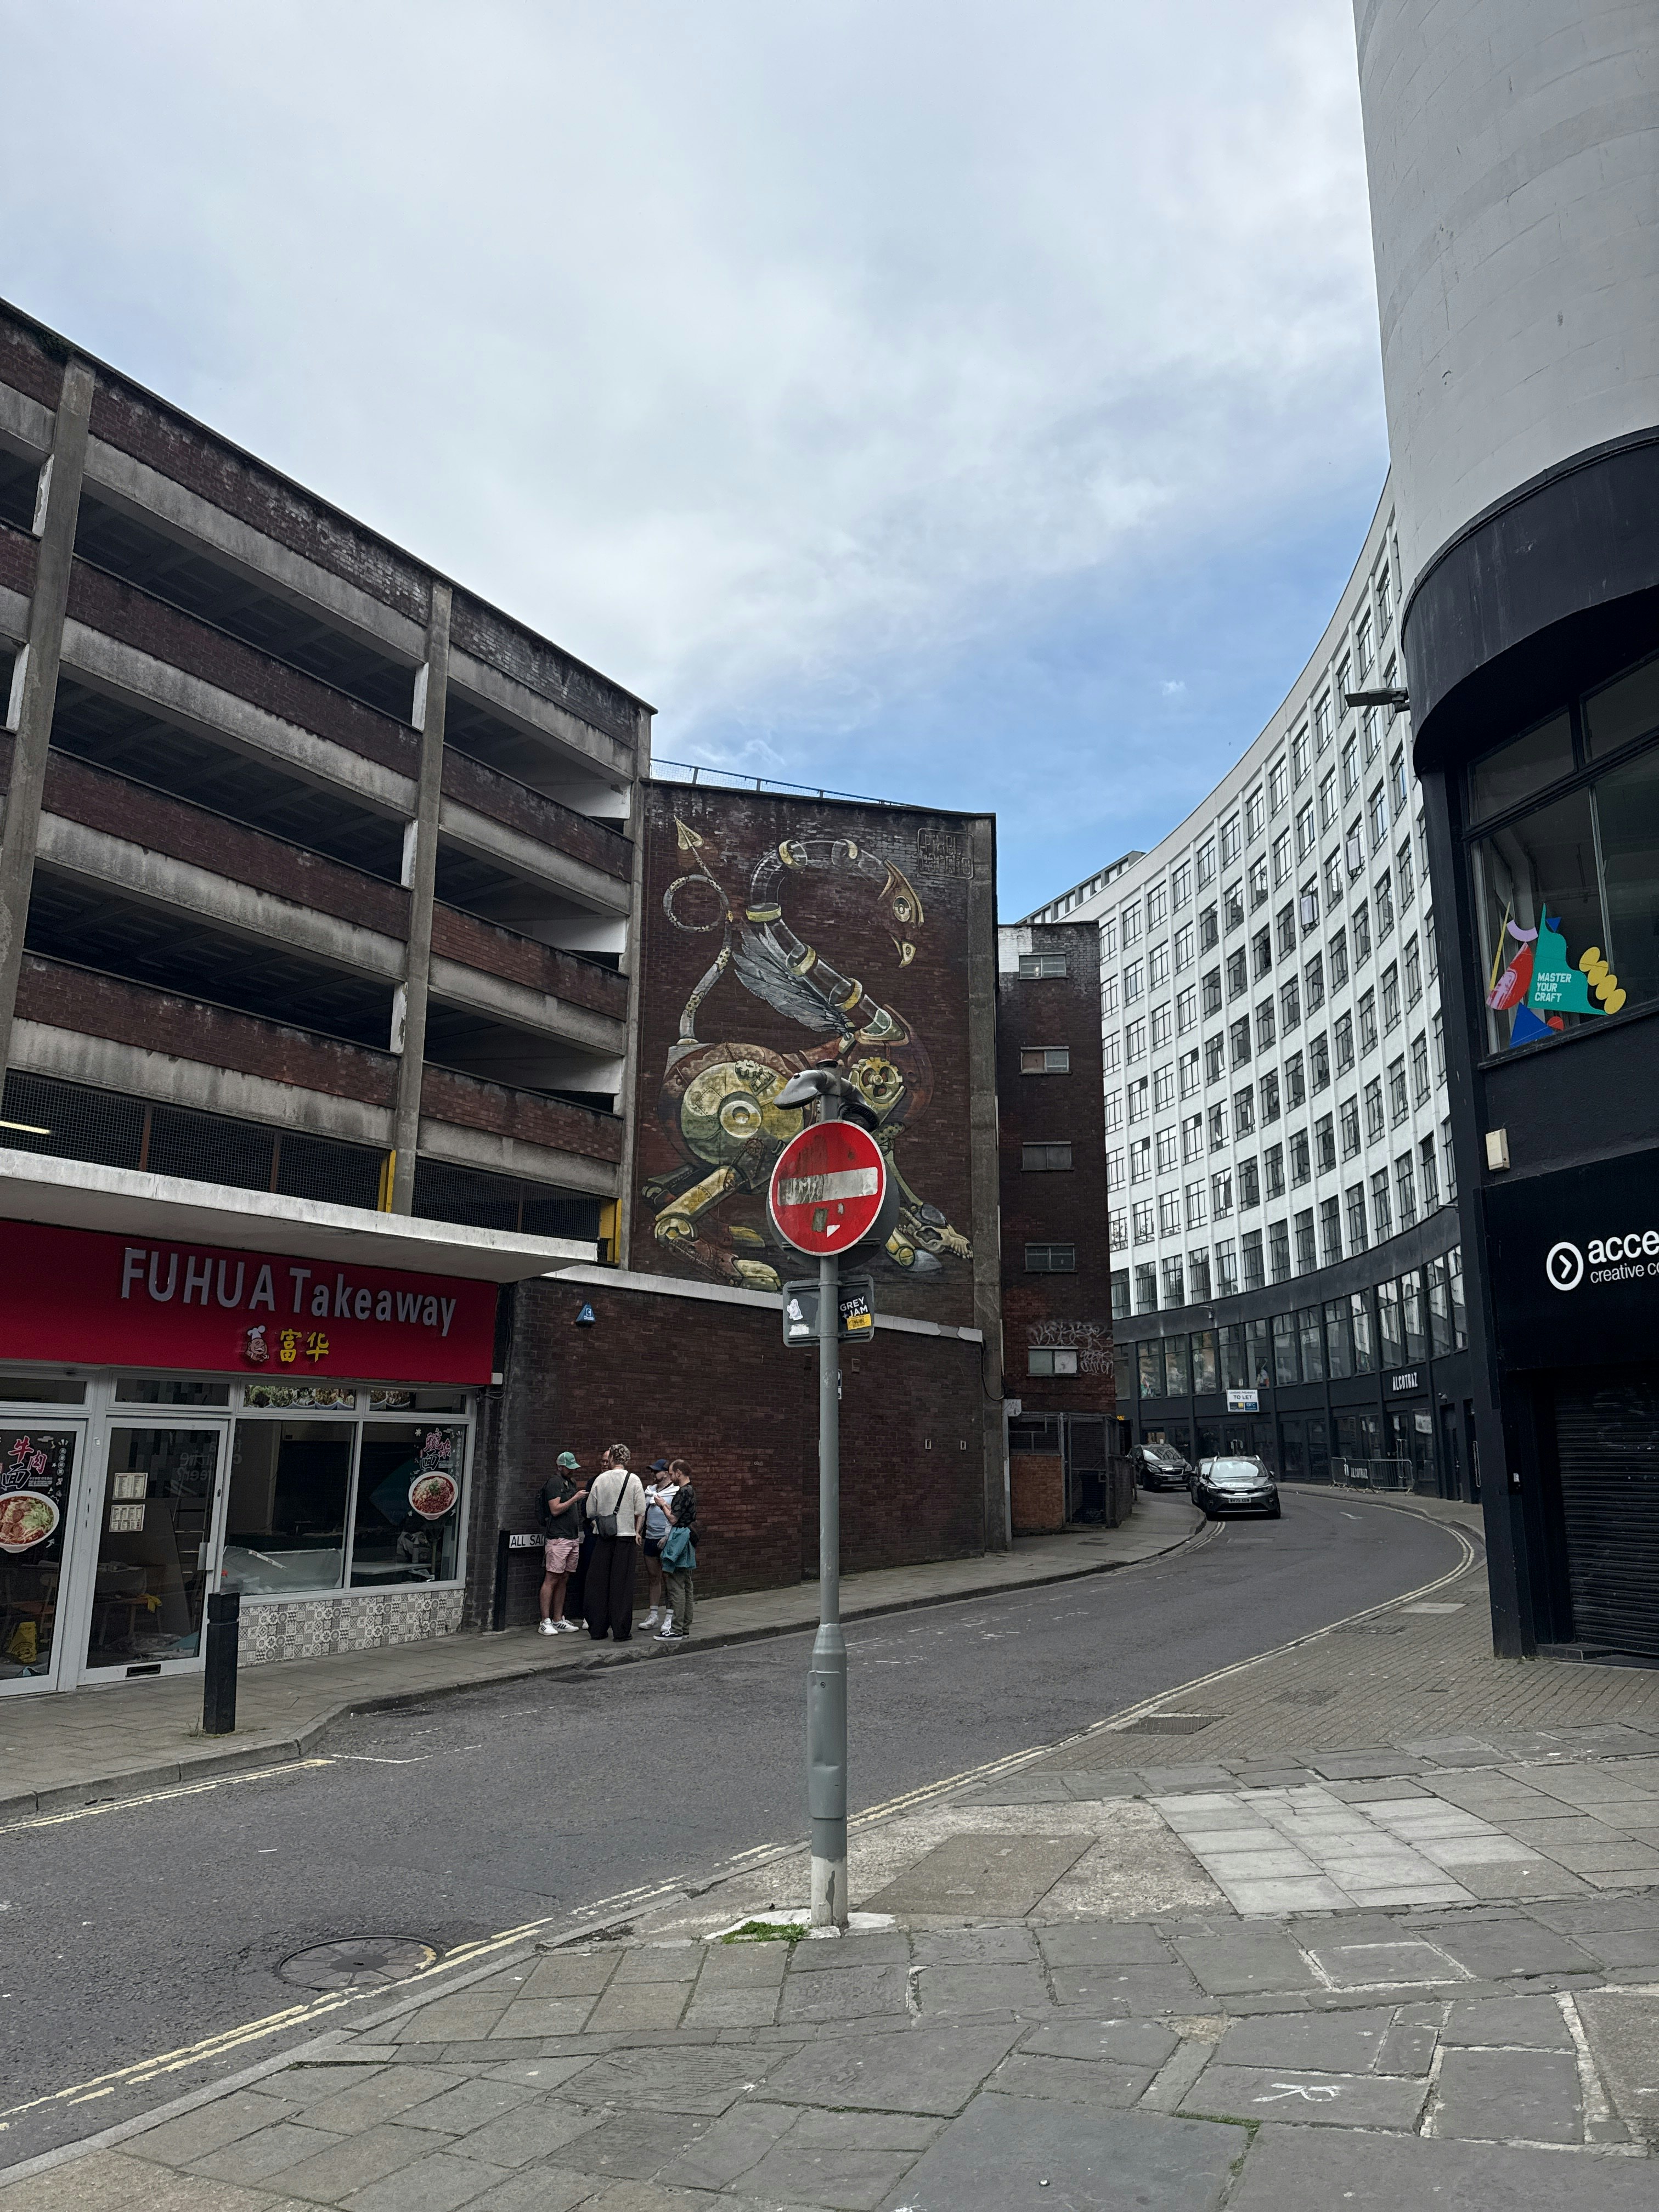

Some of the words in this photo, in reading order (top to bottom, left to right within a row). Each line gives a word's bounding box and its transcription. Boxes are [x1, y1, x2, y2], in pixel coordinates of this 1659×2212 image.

[1537, 972, 1571, 983] MASTER
[1537, 982, 1558, 992] YOUR
[1534, 992, 1562, 1002] CRAFT
[1590, 1263, 1645, 1283] creative
[120, 1247, 275, 1311] FUHUA
[289, 1267, 456, 1337] Takeaway
[840, 1296, 865, 1312] GREY
[279, 1328, 330, 1363] 富华
[1392, 1372, 1418, 1391] ALCOTRAZ
[510, 1535, 526, 1547] ALL
